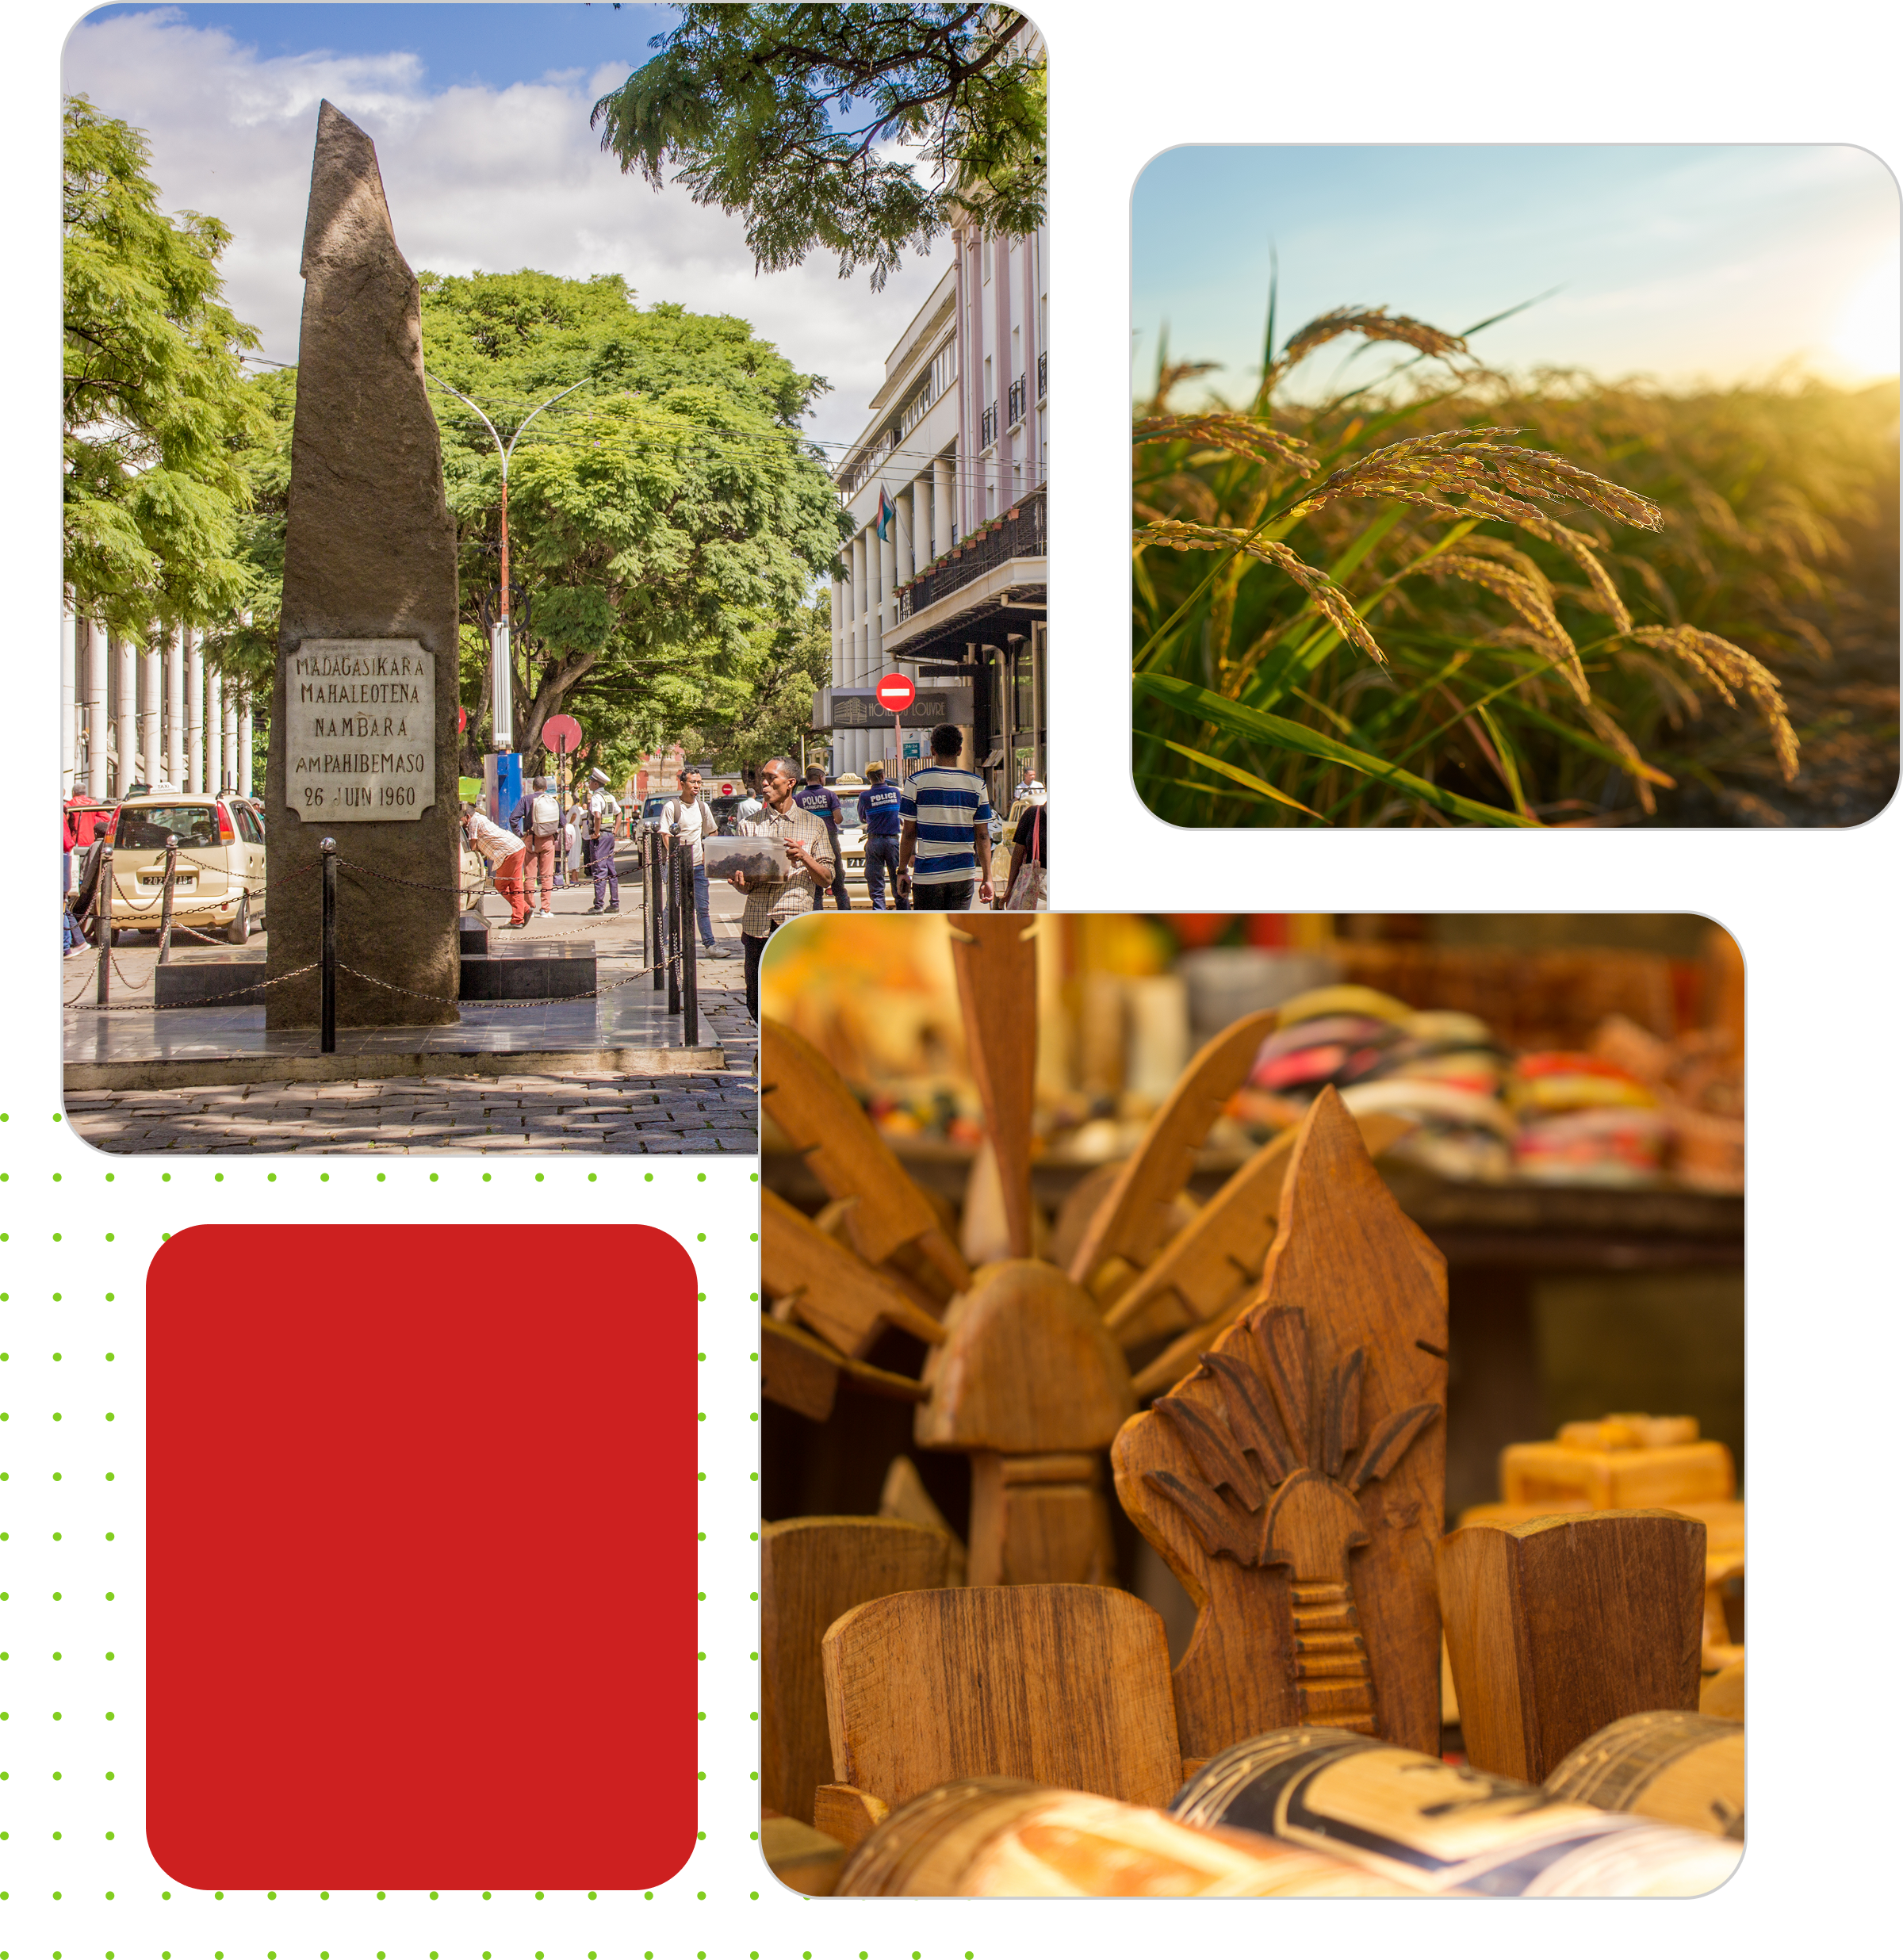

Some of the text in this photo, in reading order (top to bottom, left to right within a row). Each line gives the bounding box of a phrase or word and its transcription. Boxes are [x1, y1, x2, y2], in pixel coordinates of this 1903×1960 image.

[296, 657, 424, 676] MADAGASIKARA
[301, 683, 420, 703] MAHALEOTENA
[912, 702, 945, 716] LOUVRE
[315, 717, 408, 737] NAMBARA
[296, 753, 424, 773] AMPAHIBEMASO
[304, 787, 415, 807] 26 JUIN 1960
[802, 794, 828, 806] POLICE
[870, 791, 898, 802] POLICE
